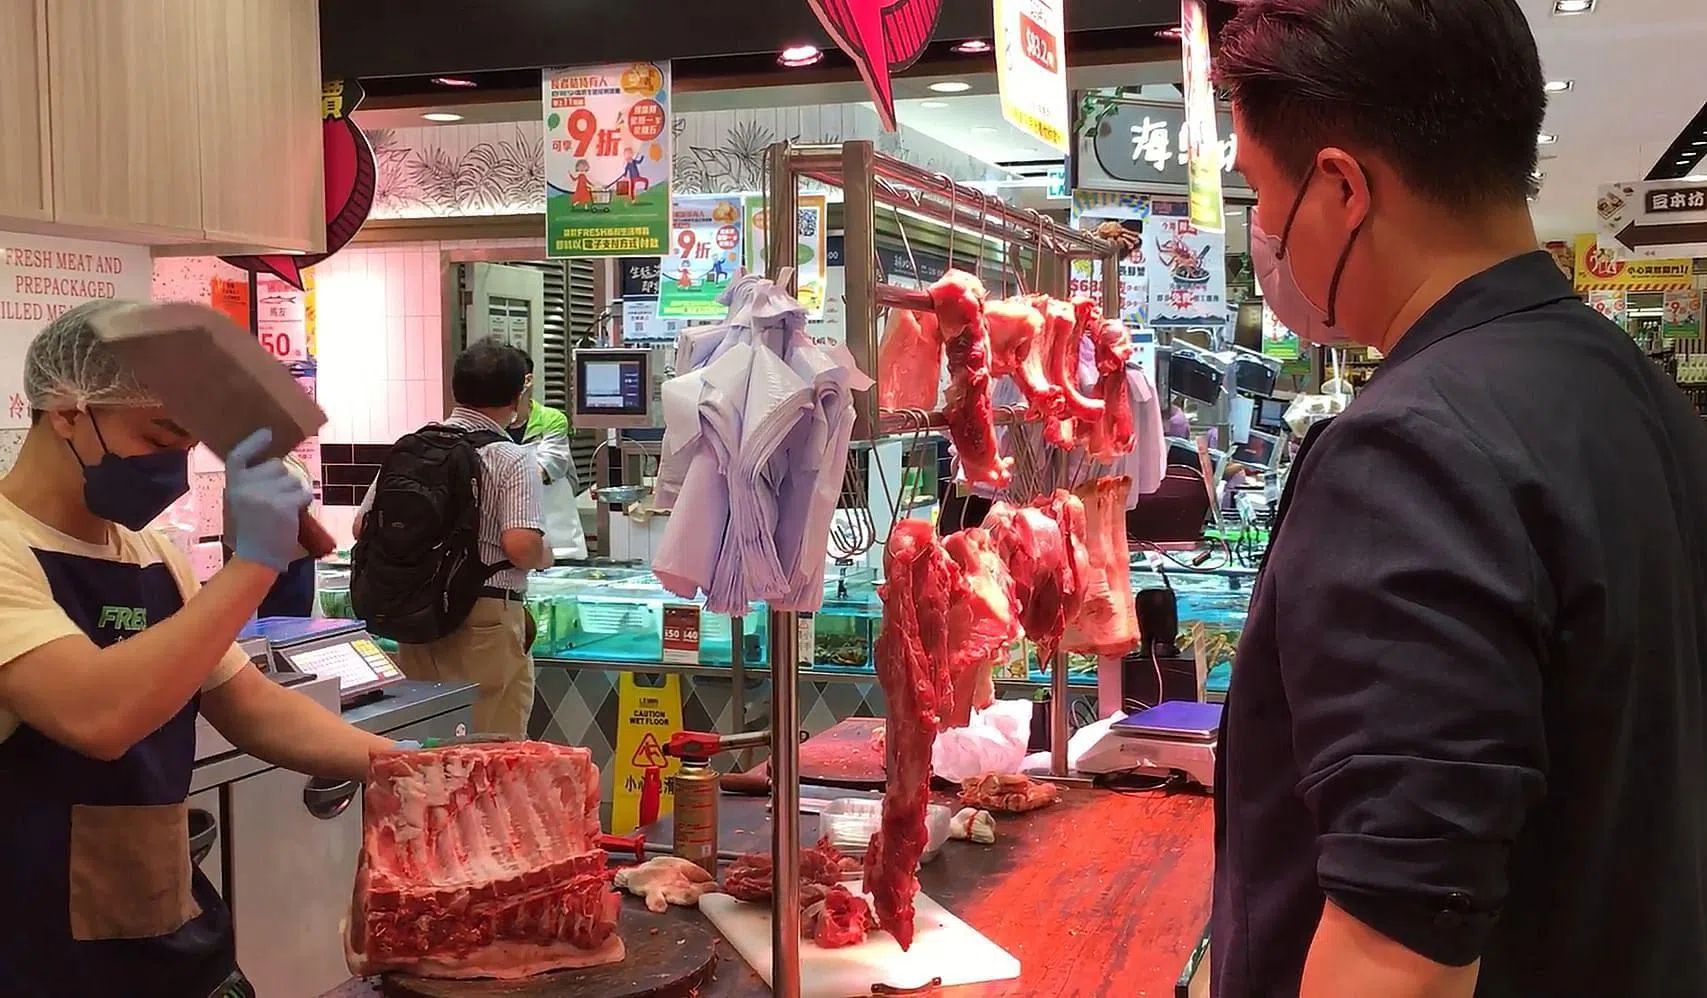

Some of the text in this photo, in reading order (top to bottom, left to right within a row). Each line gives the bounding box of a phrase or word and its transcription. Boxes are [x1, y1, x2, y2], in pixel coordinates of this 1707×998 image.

[5, 248, 122, 274] FRESH MEAT AND
[16, 275, 115, 299] PREPACKAGED
[46, 303, 73, 321] ME
[98, 605, 146, 631] FRE
[634, 710, 665, 718] CAUTION
[645, 718, 669, 726] FLOOR
